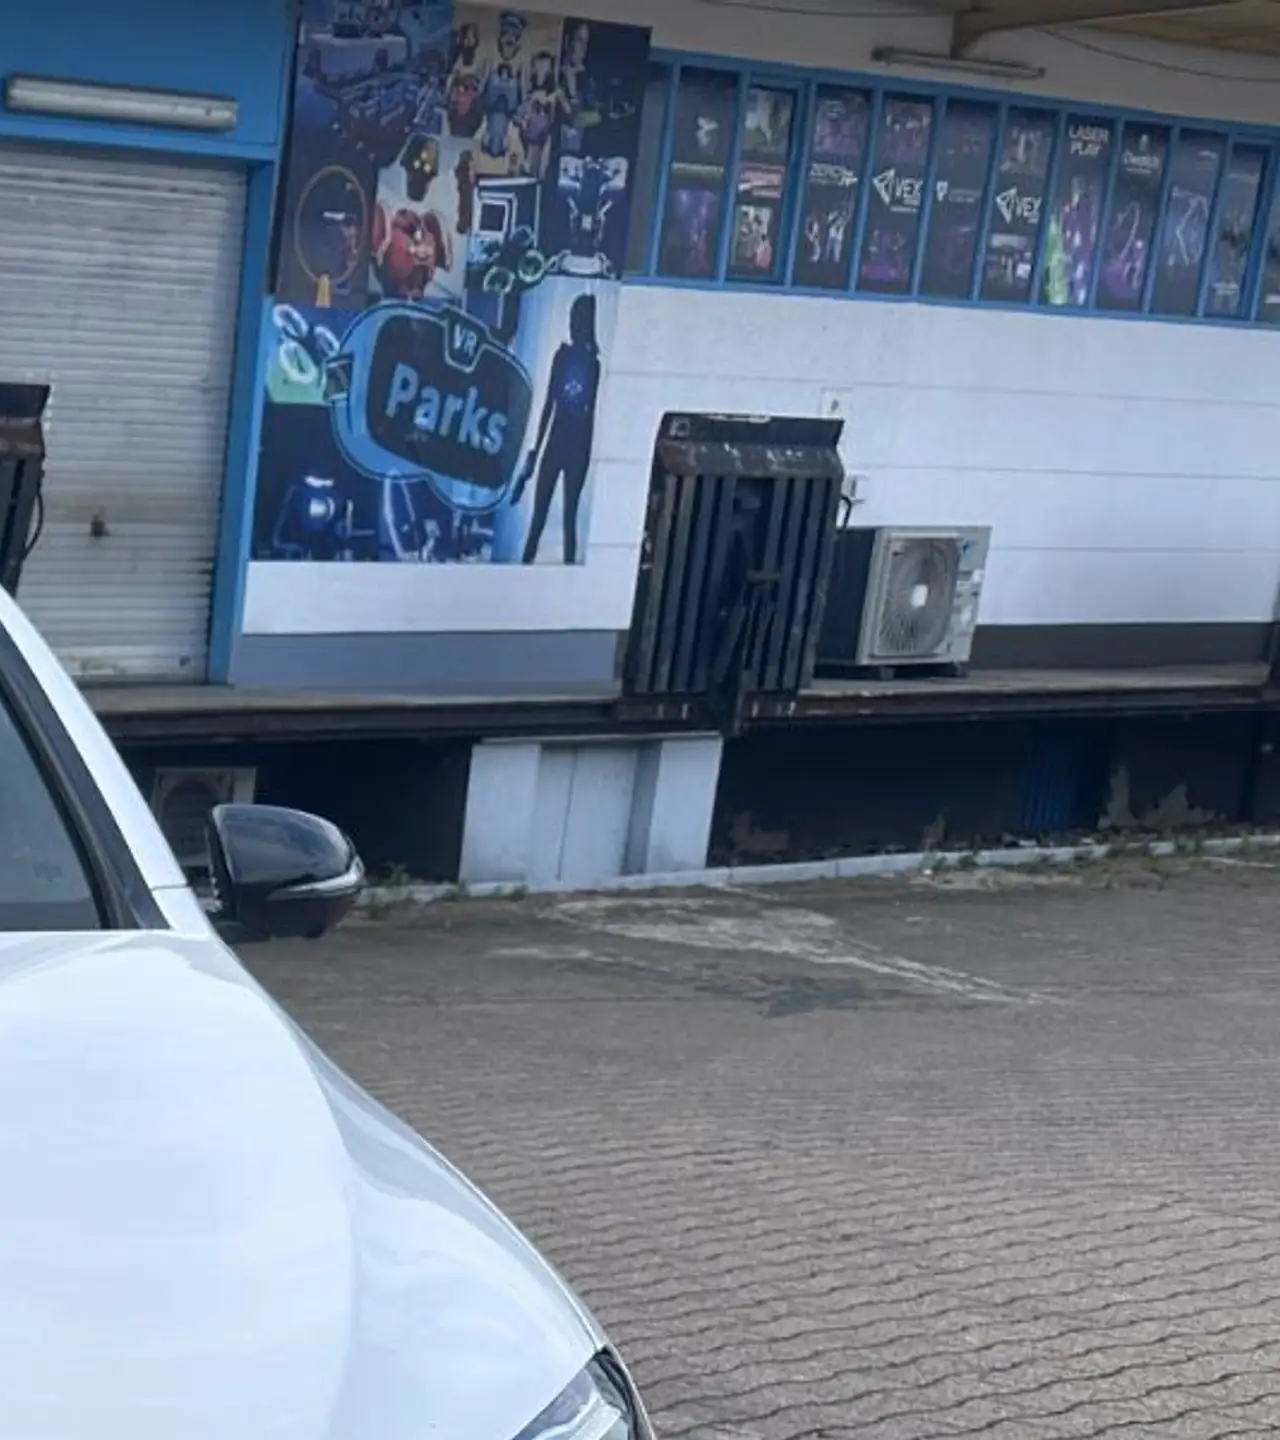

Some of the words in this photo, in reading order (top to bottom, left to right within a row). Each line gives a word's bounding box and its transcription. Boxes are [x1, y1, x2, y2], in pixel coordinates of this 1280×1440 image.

[1068, 124, 1110, 143] LASER
[1070, 141, 1101, 157] PLAY
[454, 323, 477, 356] VR
[385, 362, 508, 455] Parks
